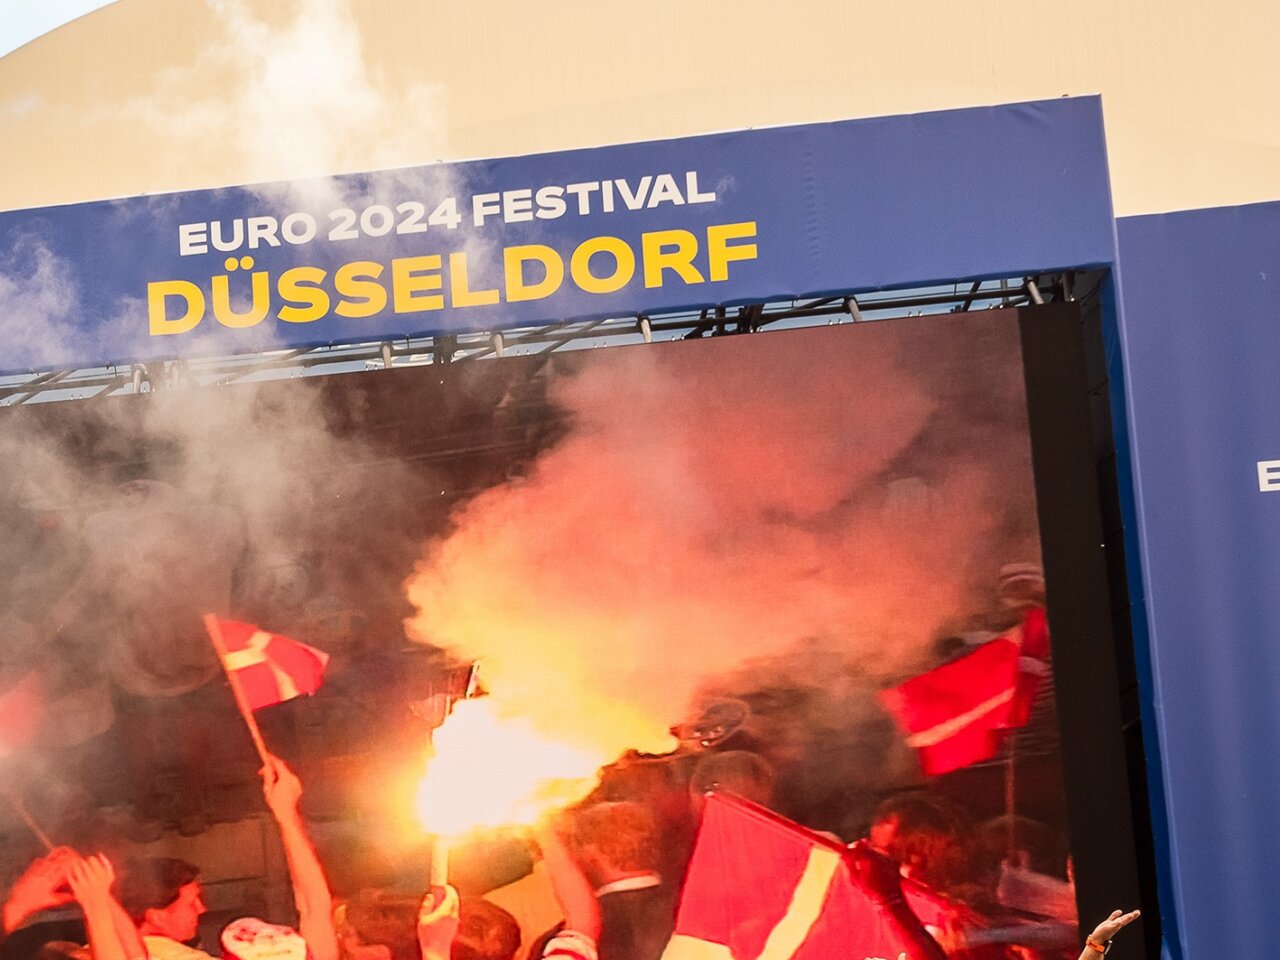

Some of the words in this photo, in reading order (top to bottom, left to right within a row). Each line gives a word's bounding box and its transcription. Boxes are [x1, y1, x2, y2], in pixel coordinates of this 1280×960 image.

[178, 211, 318, 256] EURO
[328, 198, 462, 241] 2024
[472, 171, 716, 228] FESTIVAL
[147, 221, 758, 336] DÜSSELDORF
